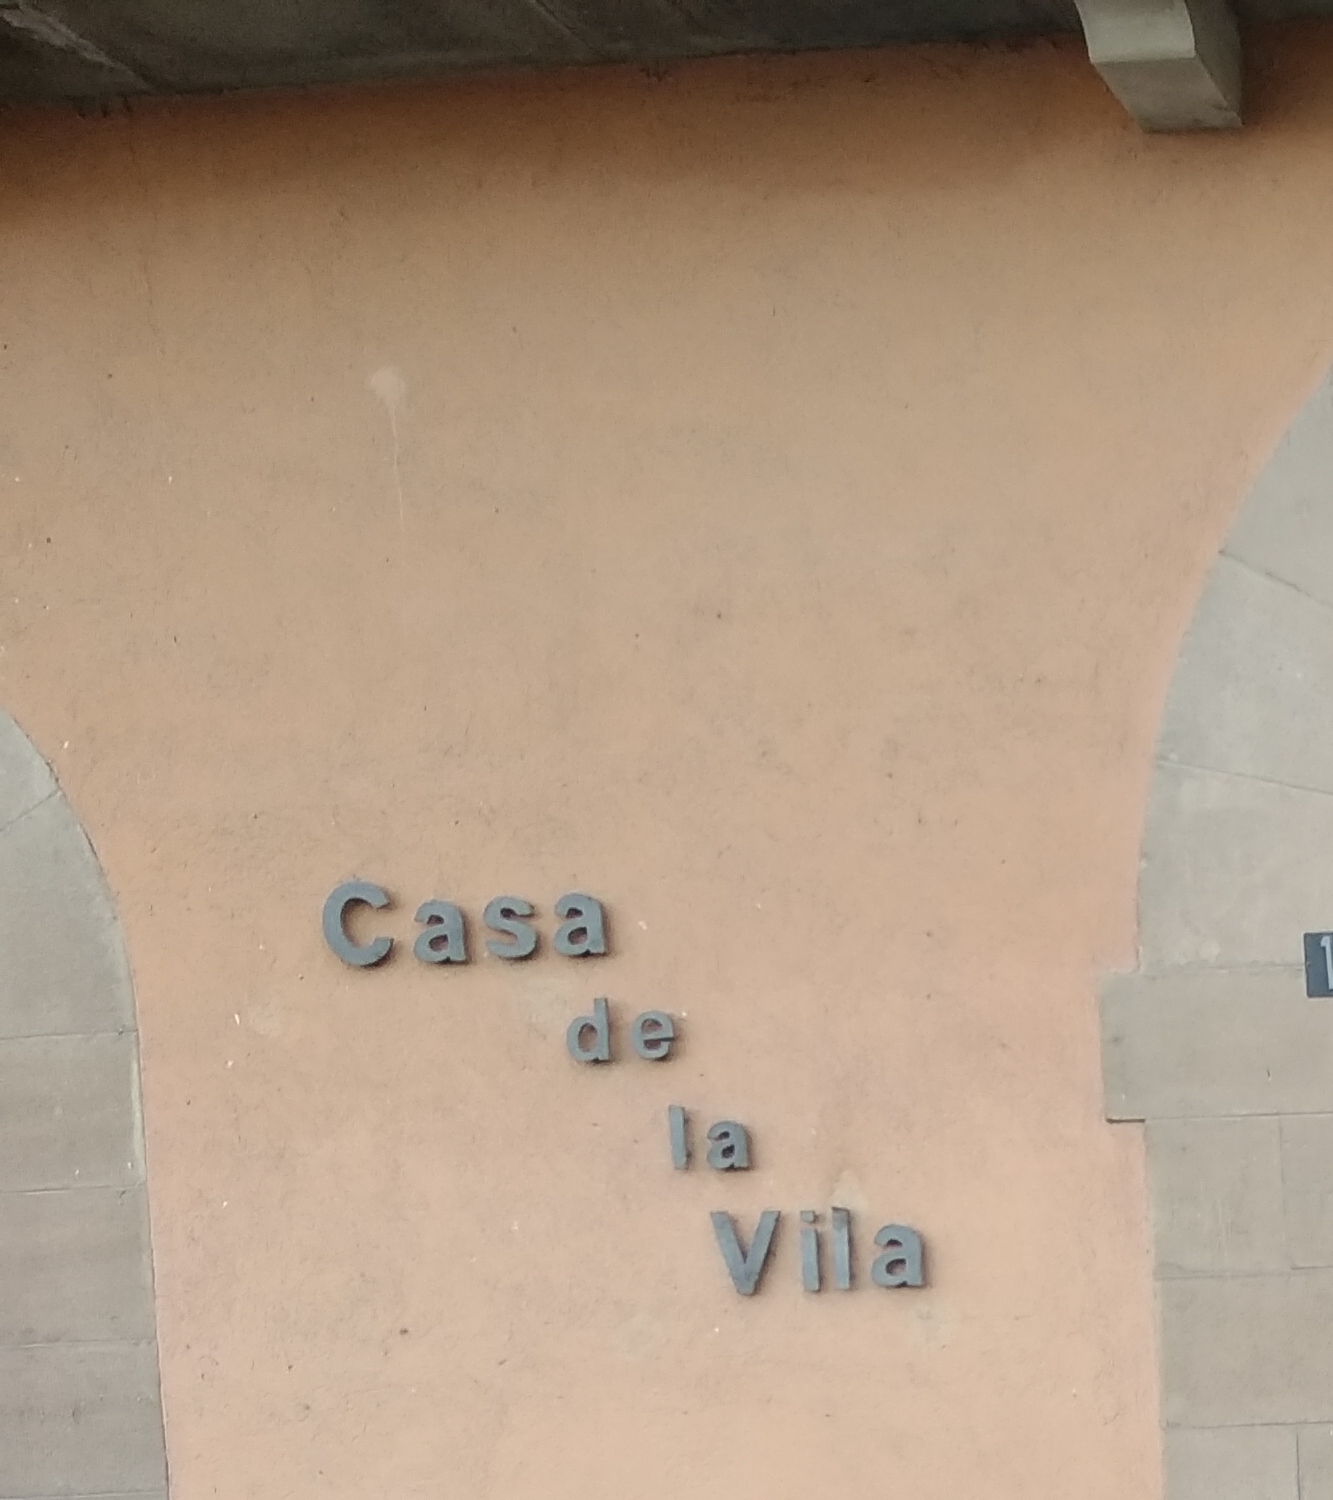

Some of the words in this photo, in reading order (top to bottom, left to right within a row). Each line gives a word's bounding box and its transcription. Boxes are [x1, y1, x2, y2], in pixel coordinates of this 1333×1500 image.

[321, 880, 608, 968] Casa
[565, 998, 676, 1063] de
[668, 1105, 752, 1171] la
[710, 1206, 927, 1297] Vila
